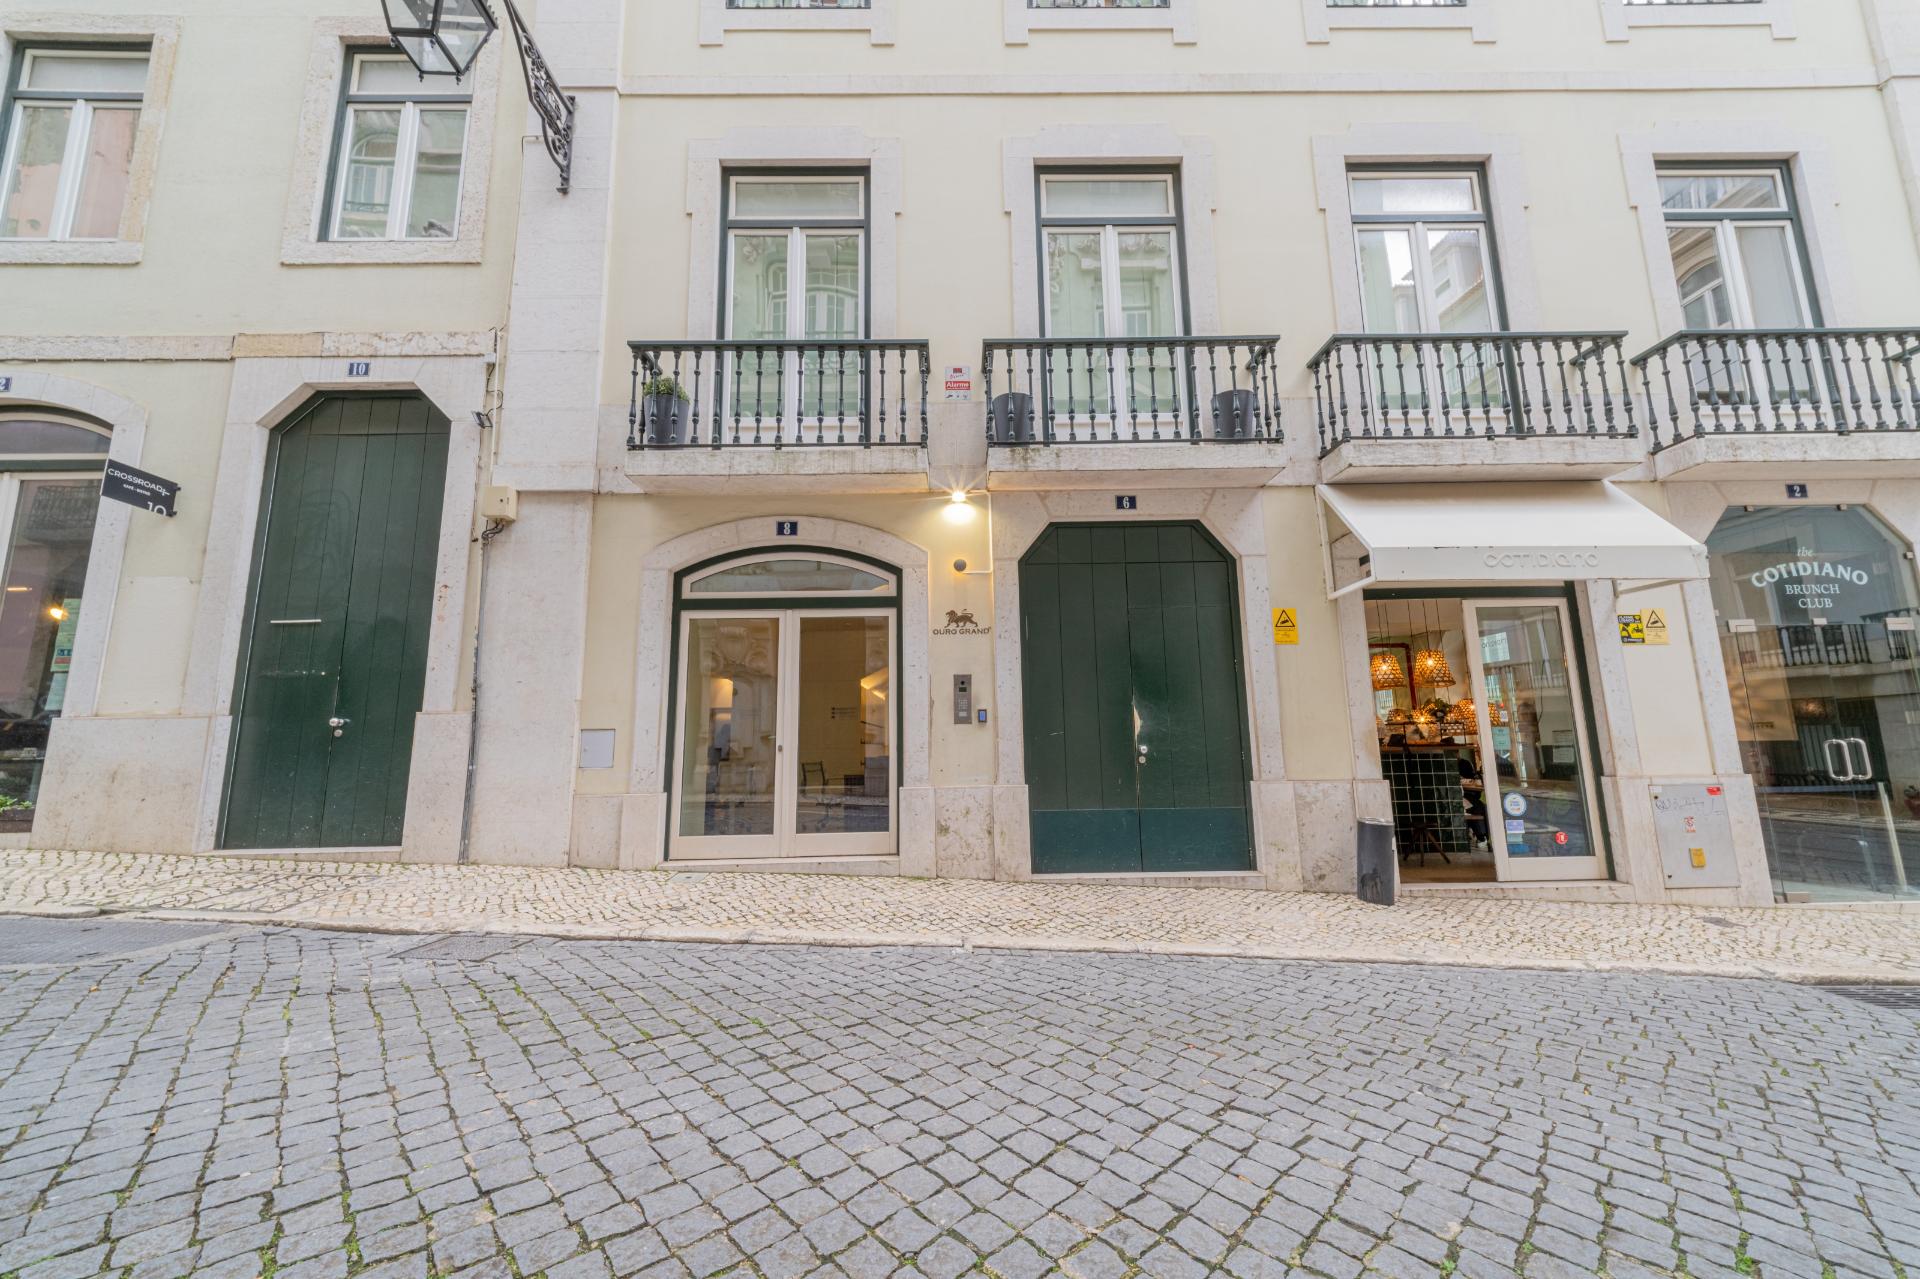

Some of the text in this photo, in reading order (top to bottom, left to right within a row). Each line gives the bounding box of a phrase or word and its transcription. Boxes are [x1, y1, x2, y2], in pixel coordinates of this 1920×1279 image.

[353, 363, 365, 375] 10
[1793, 485, 1801, 497] 2
[1123, 496, 1130, 509] 6
[783, 522, 791, 535] 8
[1797, 546, 1814, 557] the
[1751, 561, 1869, 588] COTIDIANO
[1785, 584, 1840, 595] BRUNCH
[1798, 598, 1833, 608] CLUB
[959, 627, 991, 635] GRAND
